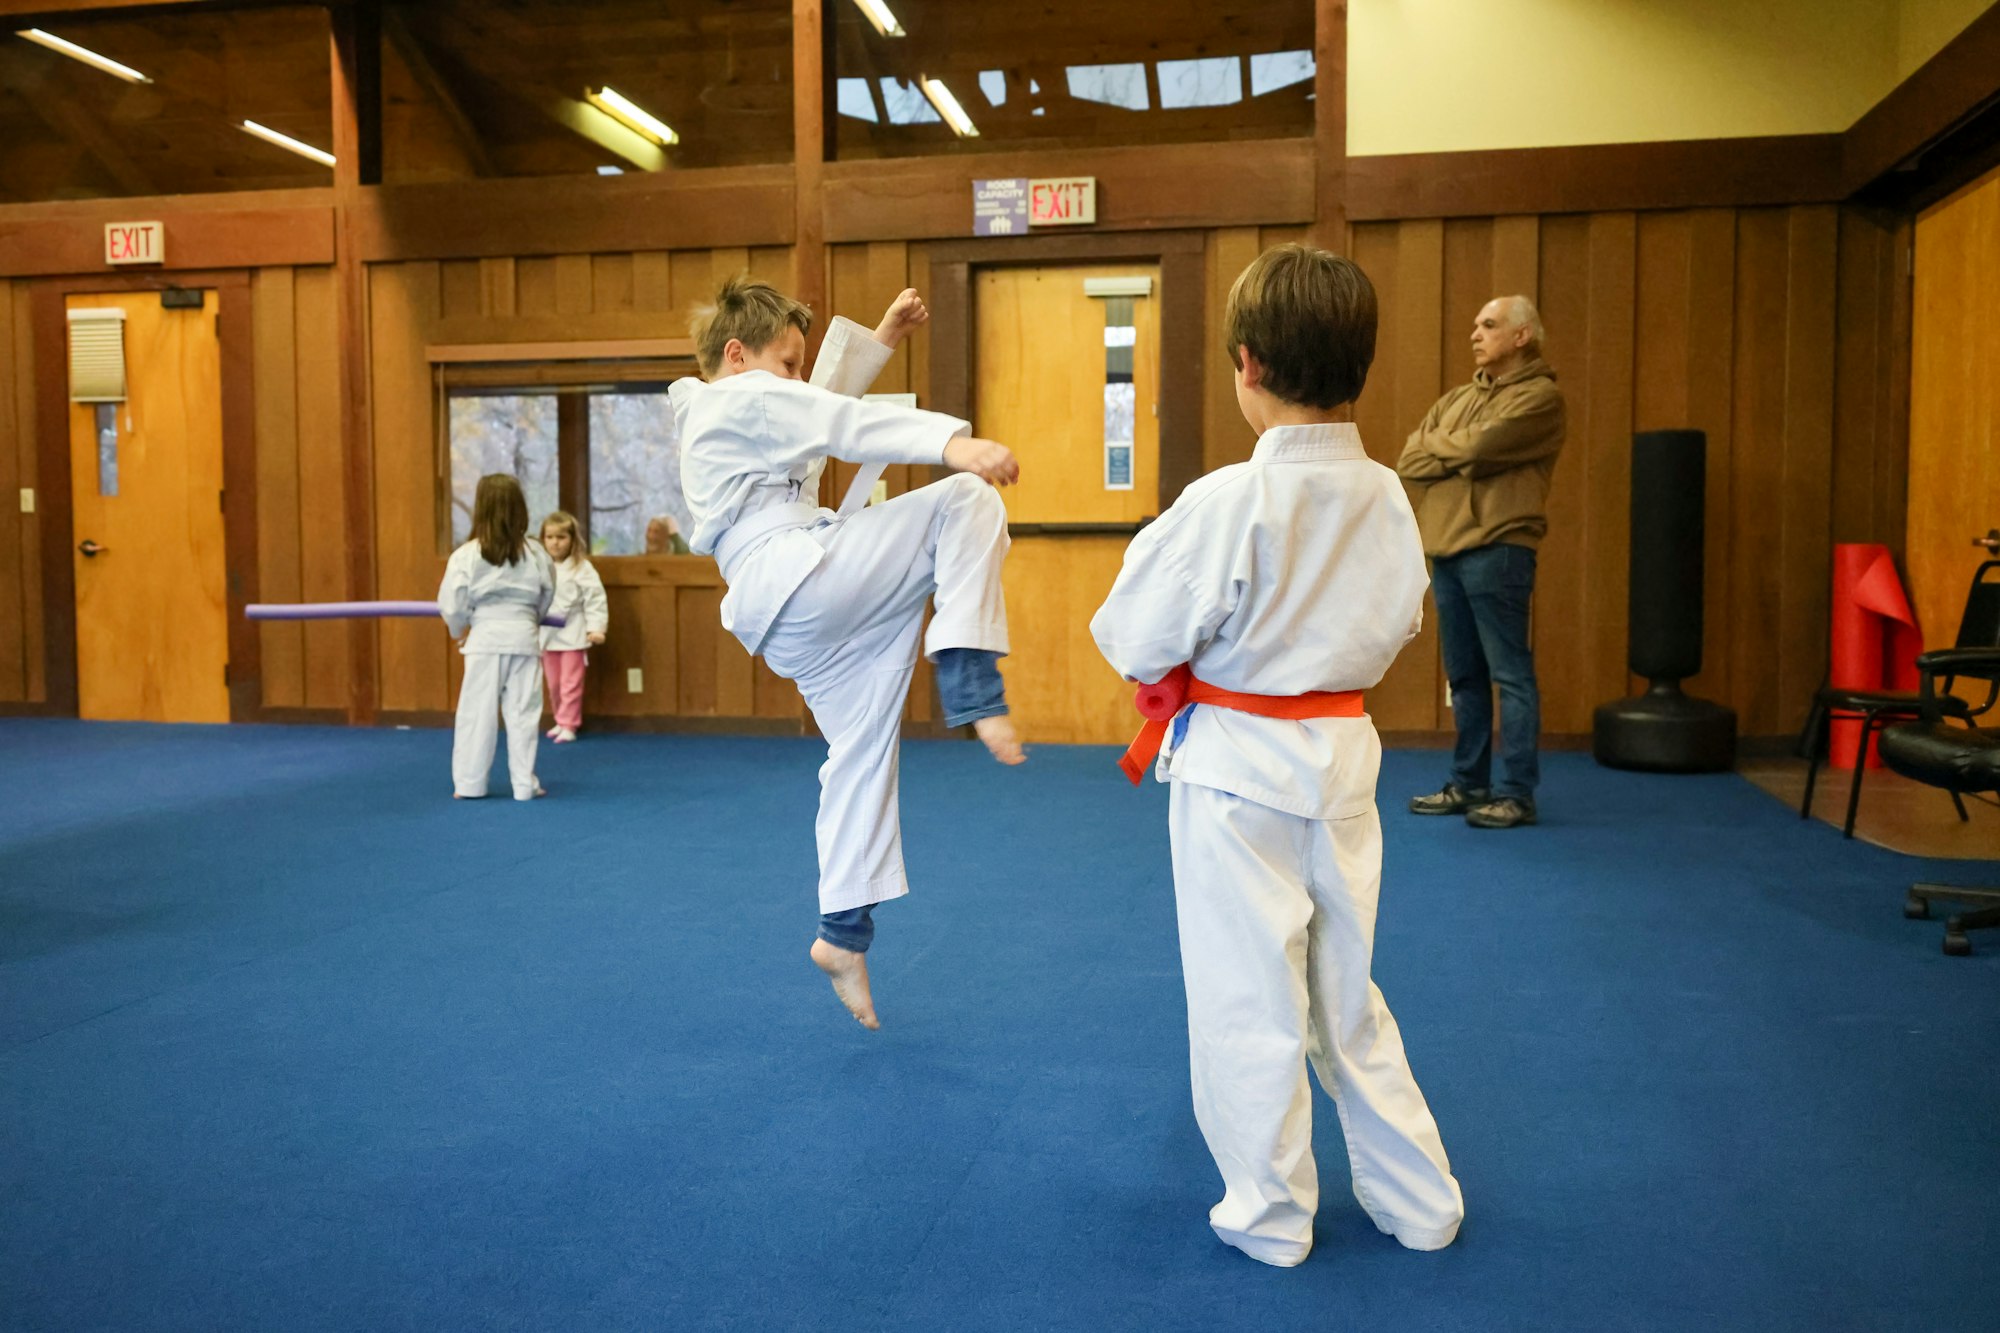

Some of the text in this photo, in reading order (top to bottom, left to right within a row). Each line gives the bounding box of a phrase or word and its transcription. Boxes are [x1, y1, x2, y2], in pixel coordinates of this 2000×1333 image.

[977, 189, 1024, 199] CAPACITY
[986, 180, 1016, 189] ROOM
[1032, 183, 1089, 218] EXIT
[110, 227, 154, 259] EXIT
